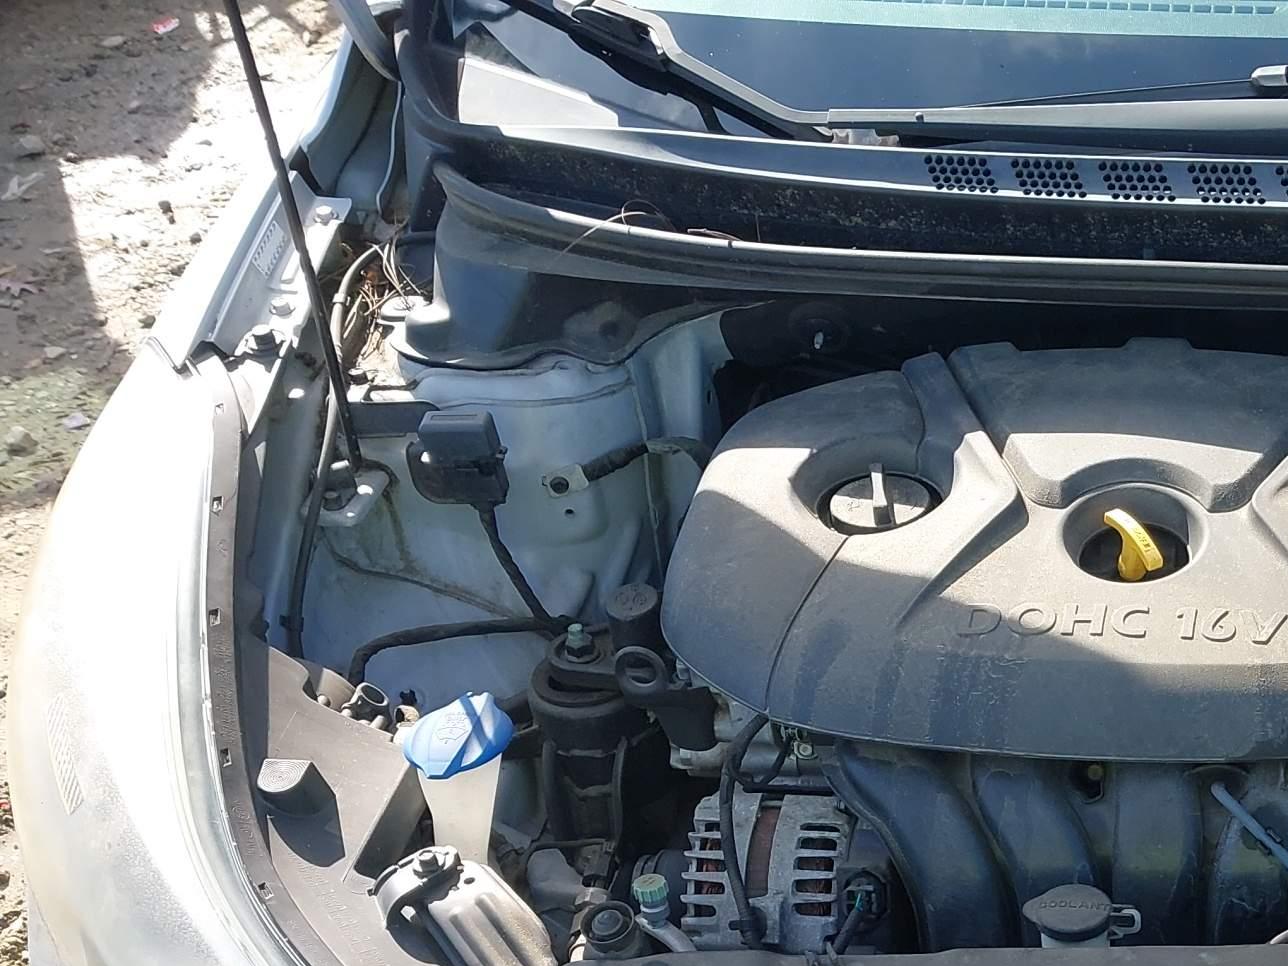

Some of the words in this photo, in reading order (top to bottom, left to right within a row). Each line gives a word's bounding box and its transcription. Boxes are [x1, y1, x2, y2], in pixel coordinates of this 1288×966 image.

[956, 602, 1151, 639] DOHC
[1175, 606, 1288, 646] 16V
[1039, 899, 1112, 912] COOLANT
